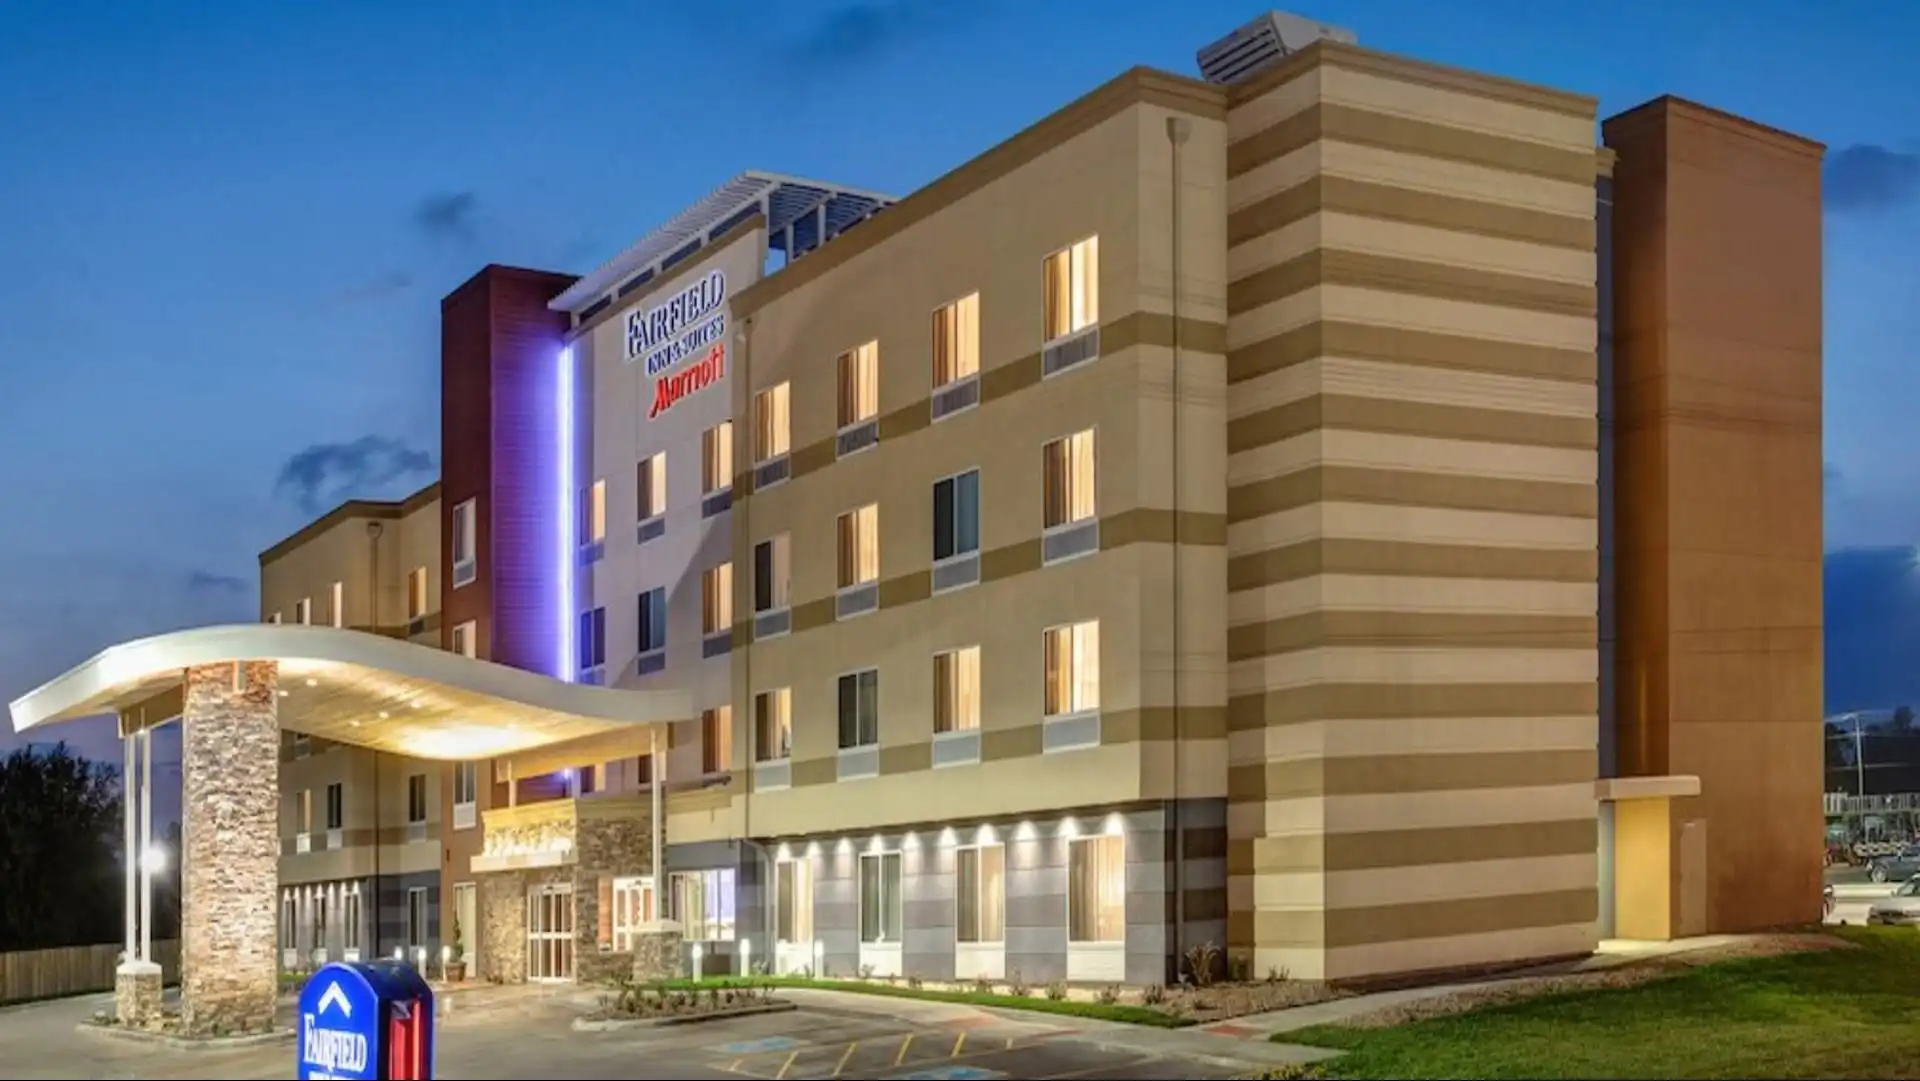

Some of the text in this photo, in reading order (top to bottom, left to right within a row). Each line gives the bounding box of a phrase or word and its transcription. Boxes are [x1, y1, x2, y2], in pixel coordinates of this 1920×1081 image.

[626, 272, 725, 360] FAIRFIELD
[648, 343, 725, 419] Marriott
[303, 1013, 368, 1073] FAIRFIELD
